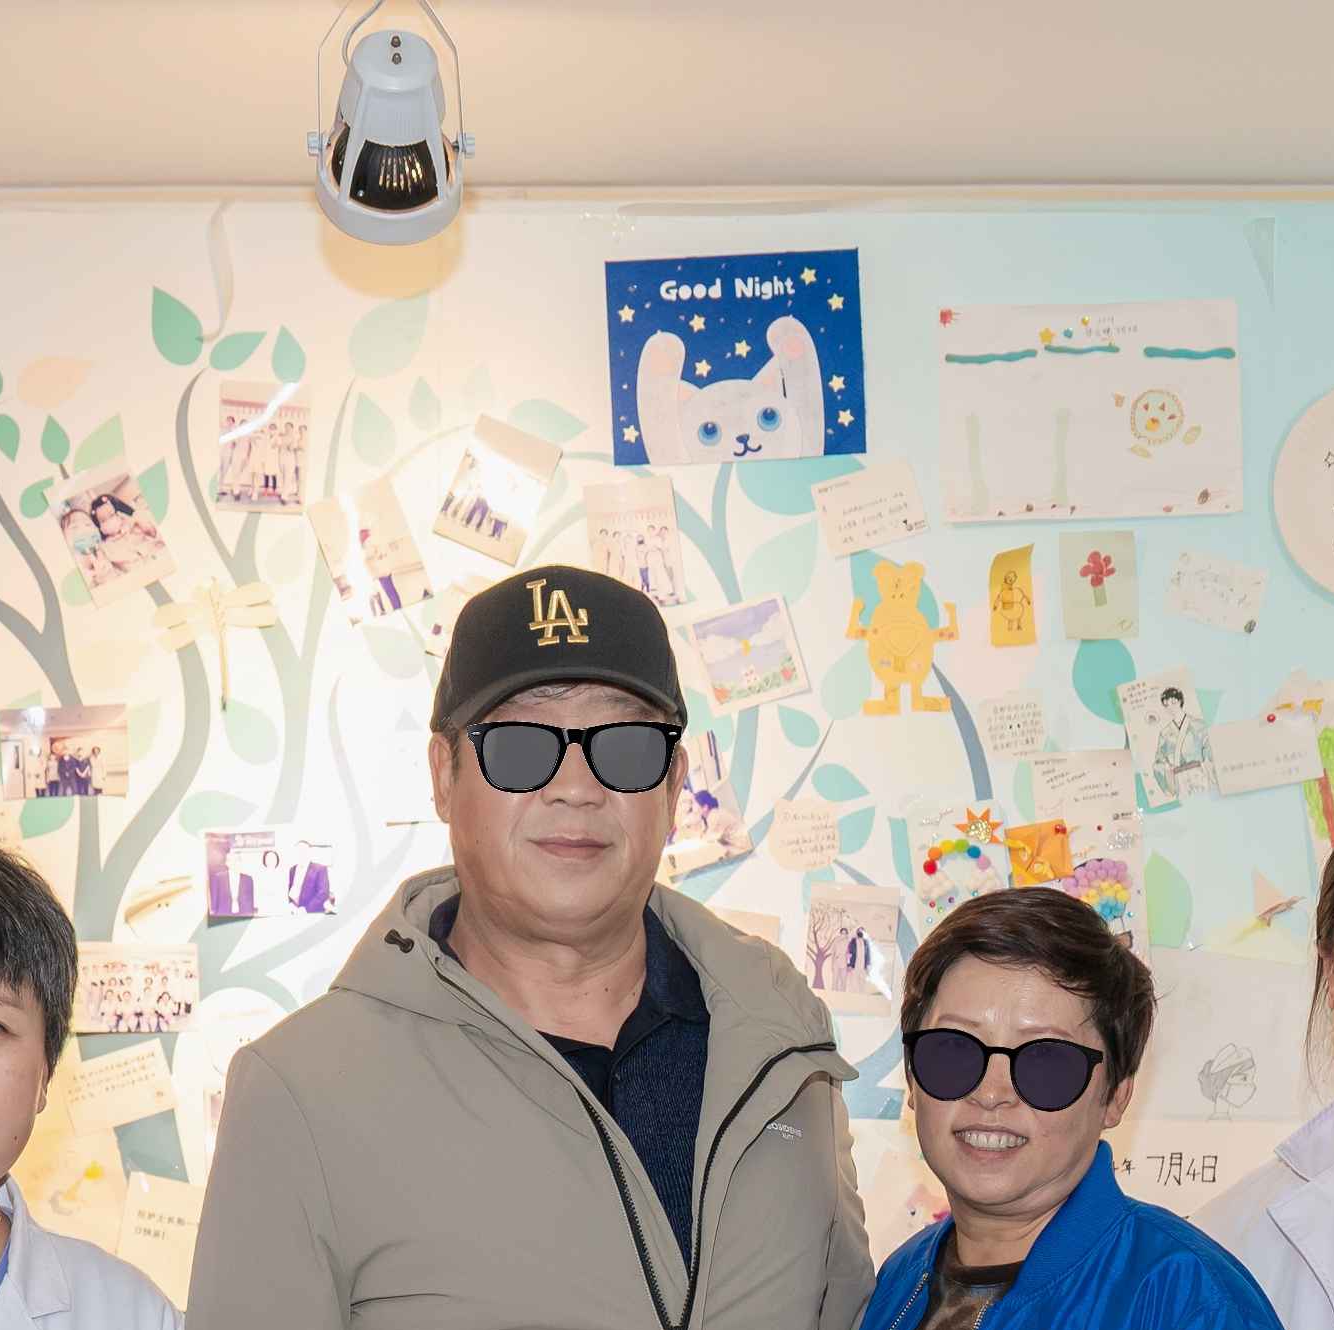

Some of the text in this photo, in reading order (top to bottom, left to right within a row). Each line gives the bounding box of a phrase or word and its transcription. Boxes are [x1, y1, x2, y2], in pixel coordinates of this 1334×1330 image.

[659, 273, 797, 301] Good Night
[525, 577, 591, 648] LA
